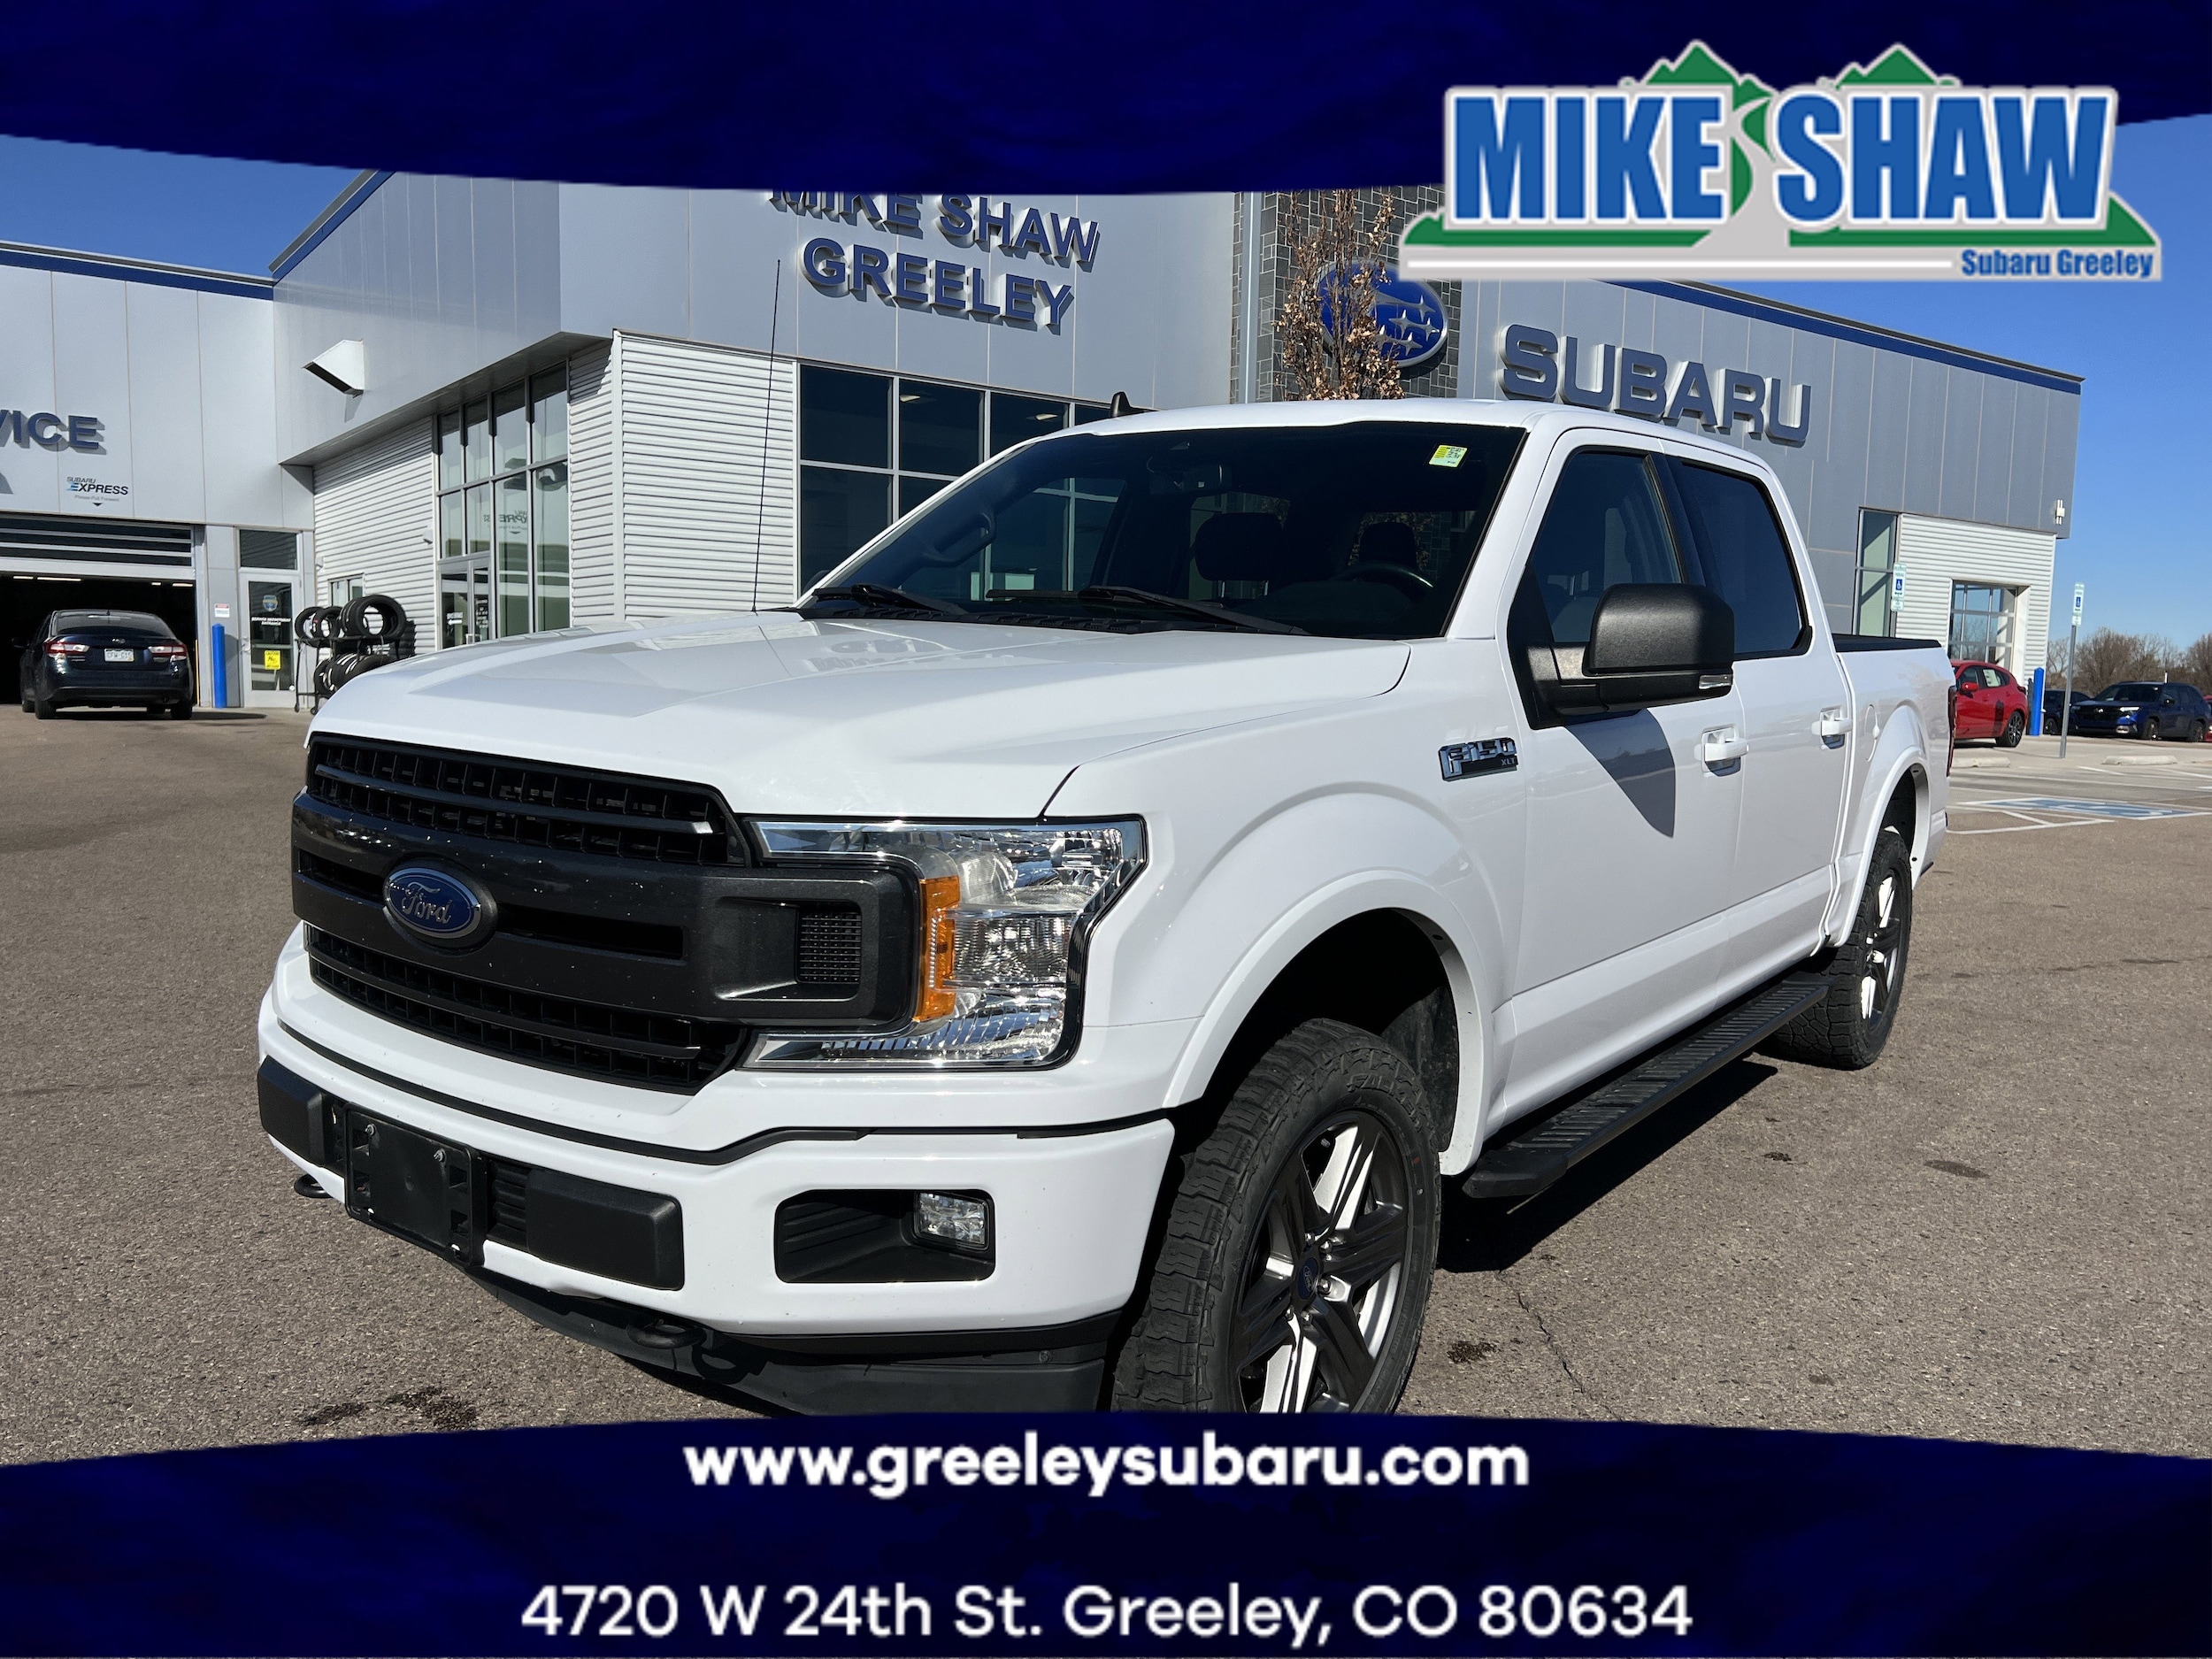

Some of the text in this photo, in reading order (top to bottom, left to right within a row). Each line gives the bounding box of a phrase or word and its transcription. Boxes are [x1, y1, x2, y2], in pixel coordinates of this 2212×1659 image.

[772, 191, 1099, 264] KE SHAW
[803, 237, 1072, 326] GREELEY
[1502, 324, 1811, 443] SUBARU
[66, 482, 129, 495] EXPRESS
[1501, 757, 1516, 766] XLT
[401, 881, 452, 925] Ford
